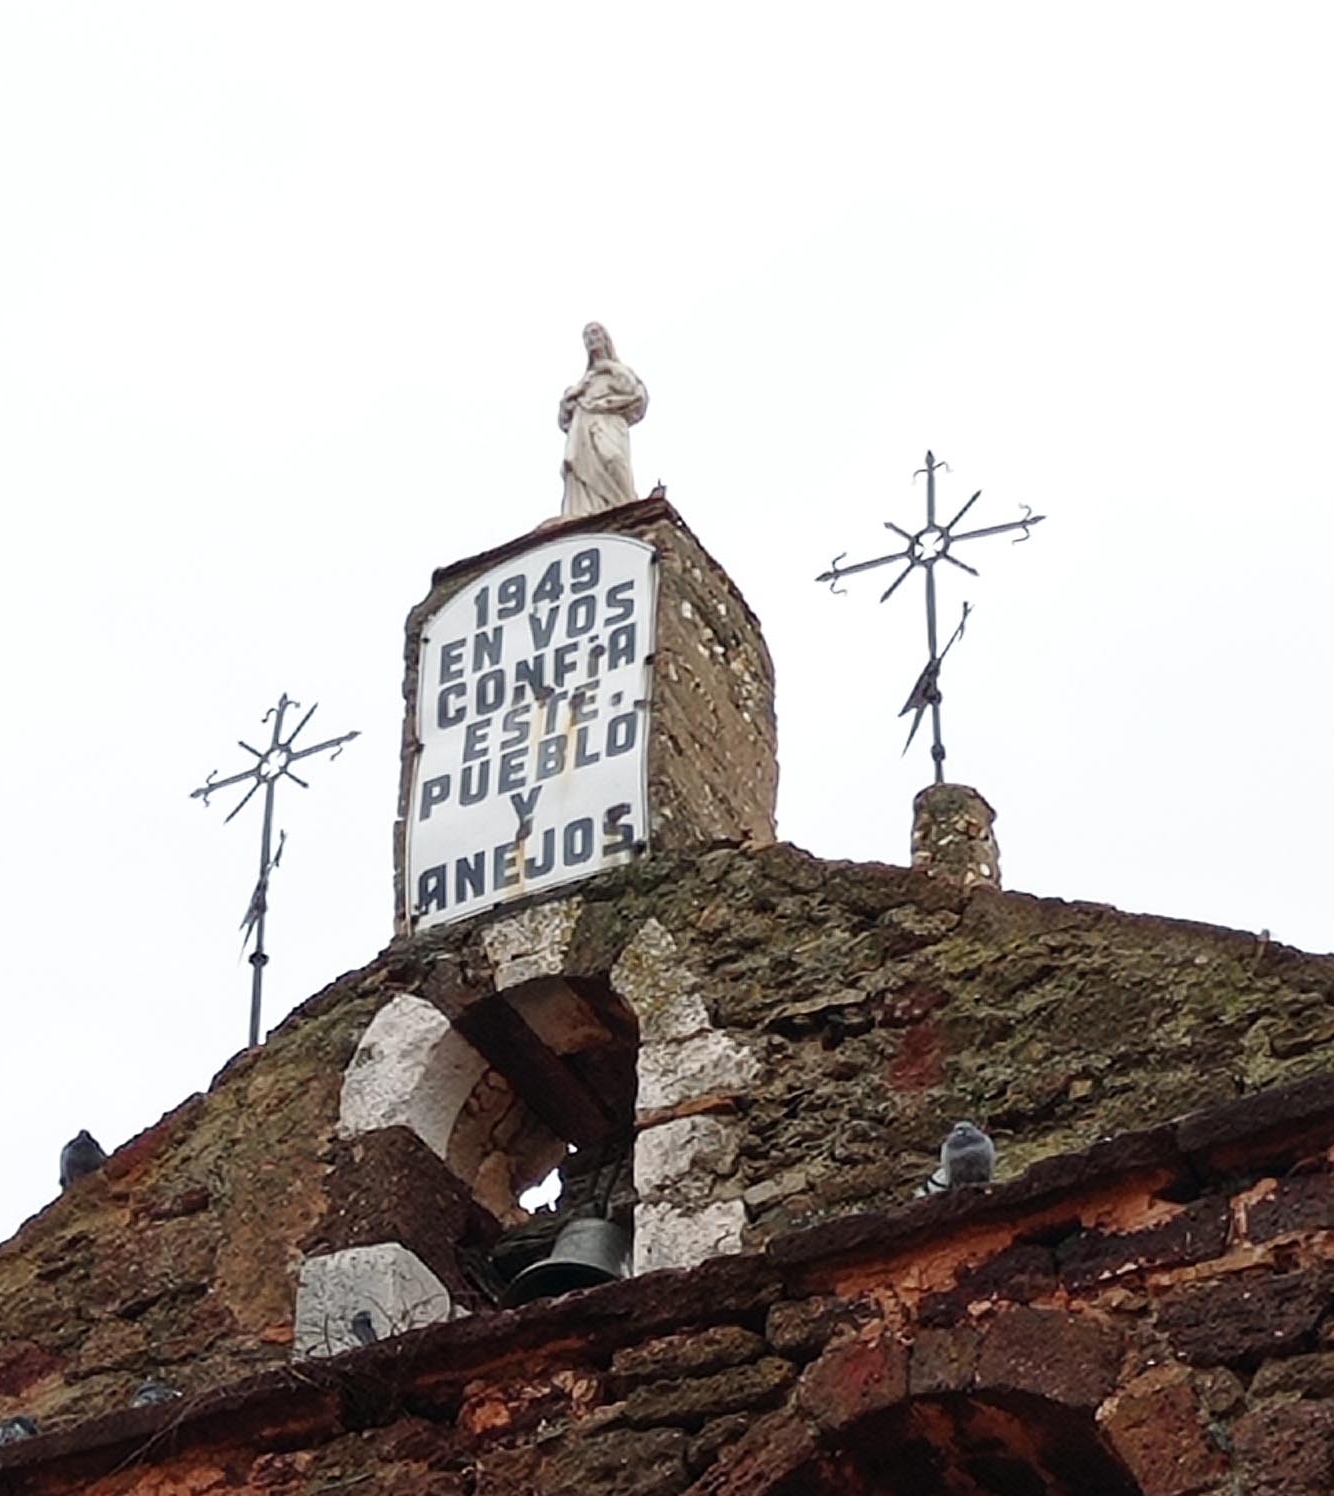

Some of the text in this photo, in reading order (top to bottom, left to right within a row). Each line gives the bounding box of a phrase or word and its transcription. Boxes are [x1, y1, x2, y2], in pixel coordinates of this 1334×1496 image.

[439, 580, 634, 686] EN VOS
[474, 547, 600, 628] 1949
[419, 711, 636, 822] PUEBLO
[510, 786, 542, 841] Y
[417, 803, 634, 915] ANEJOS
